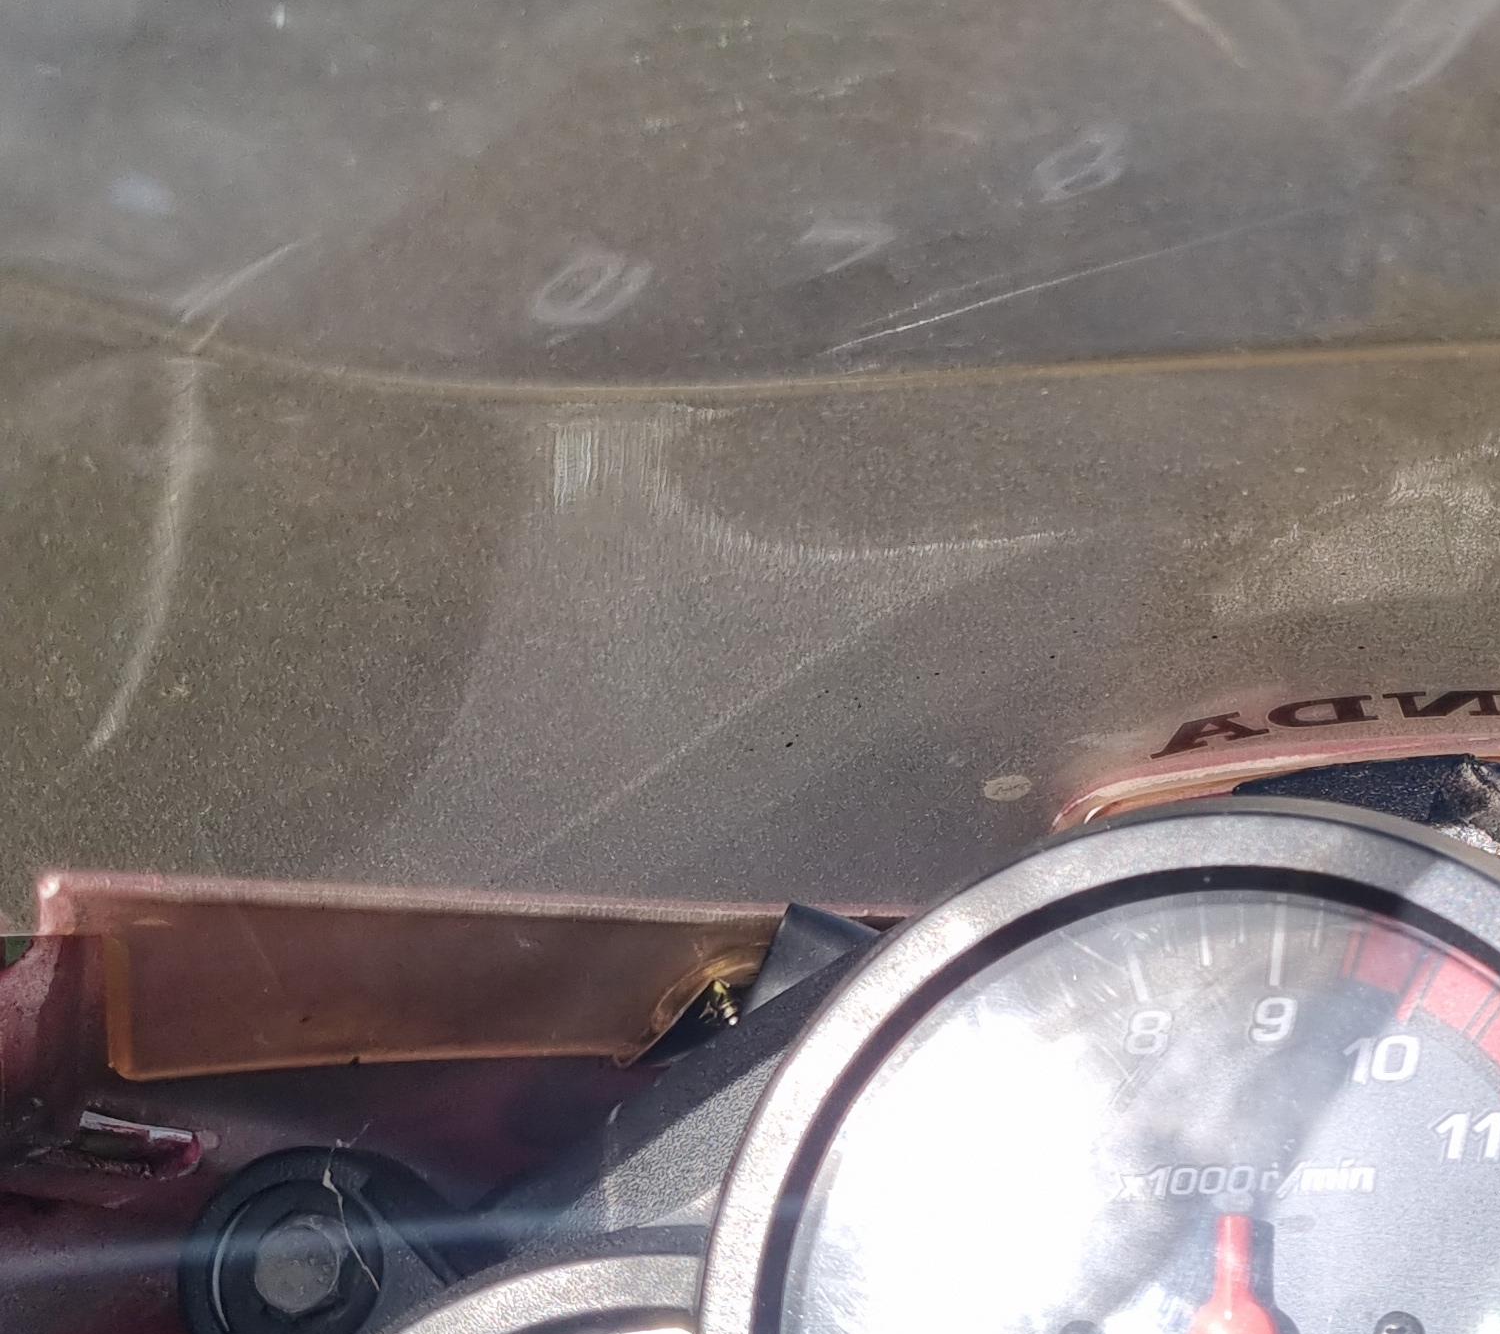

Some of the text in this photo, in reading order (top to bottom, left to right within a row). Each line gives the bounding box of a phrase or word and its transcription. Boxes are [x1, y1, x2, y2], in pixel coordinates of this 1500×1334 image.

[1124, 1009, 1174, 1056] 8
[1250, 996, 1298, 1043] 9
[1342, 1033, 1421, 1085] 10
